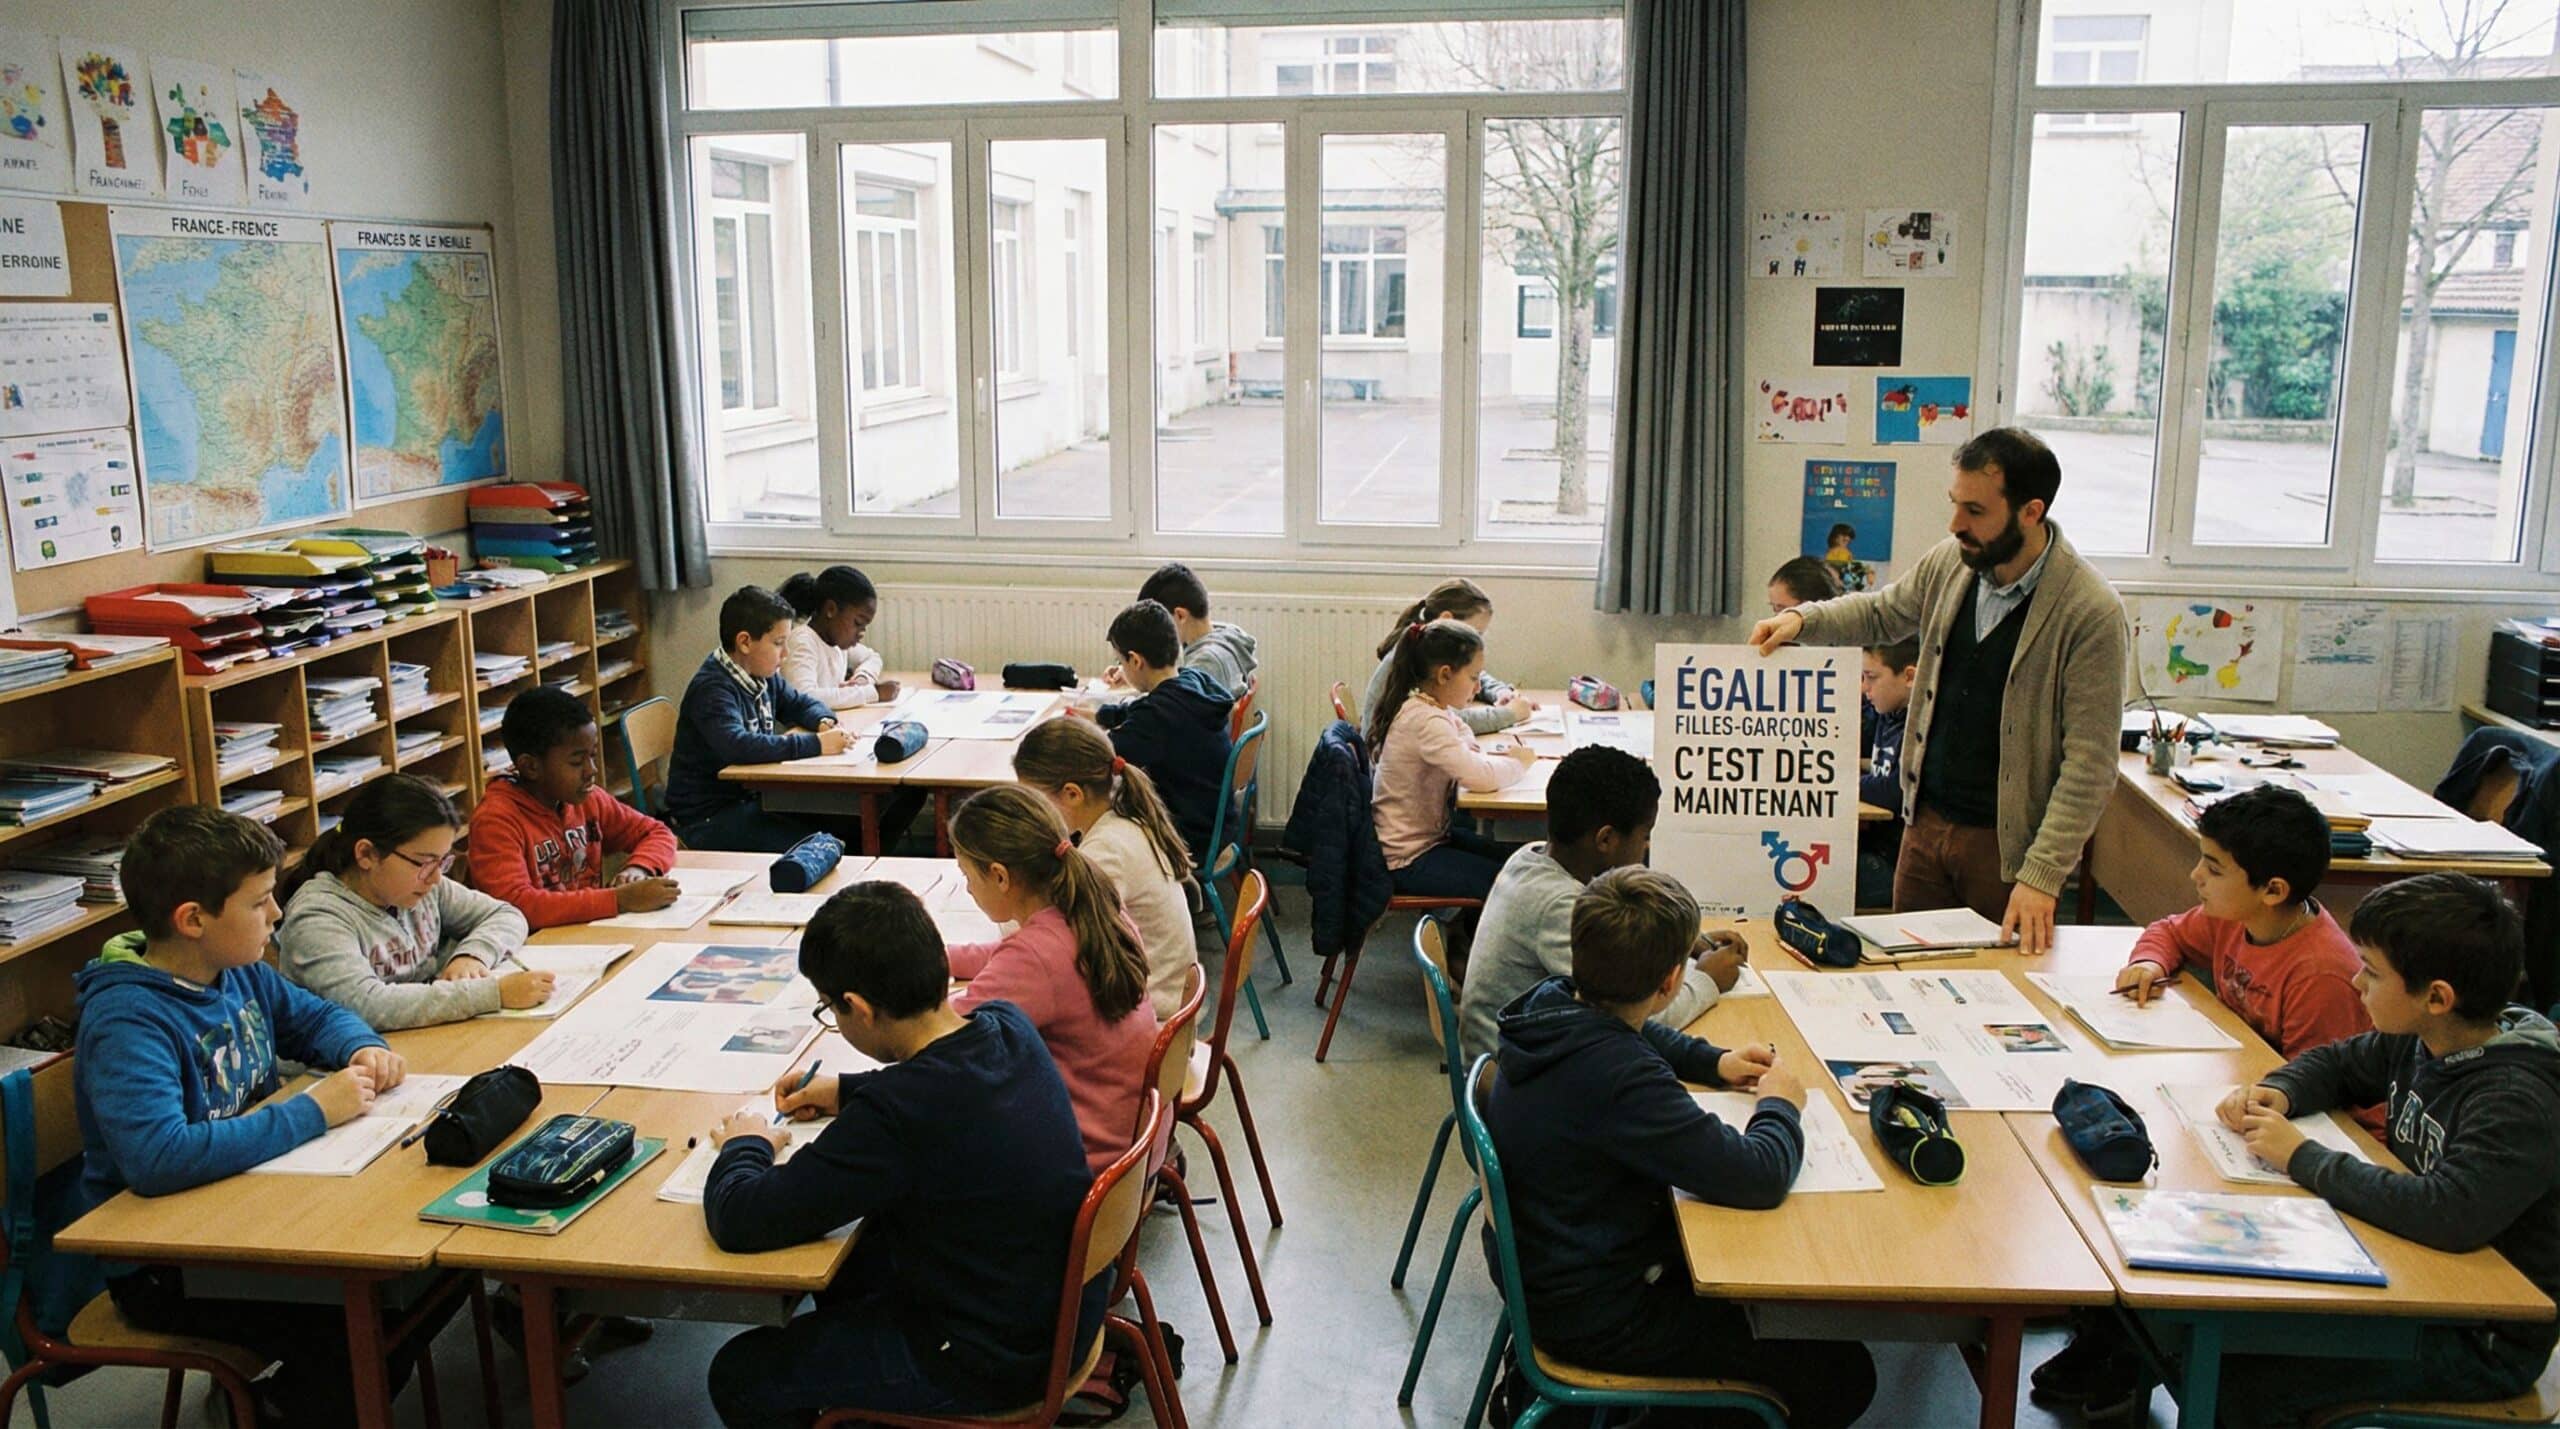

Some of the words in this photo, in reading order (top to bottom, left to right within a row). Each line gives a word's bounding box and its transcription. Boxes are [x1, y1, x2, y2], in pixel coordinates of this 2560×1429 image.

[0, 217, 25, 234] NE
[171, 217, 278, 237] FRANCE-FRENCE
[1676, 655, 1837, 714] ÉGALITÉ
[1675, 714, 1829, 742] FILLES-GARÇONS
[1674, 746, 1765, 782] C'EST
[1775, 740, 1836, 784] DÈS
[1673, 786, 1839, 819] MAINTENANT
